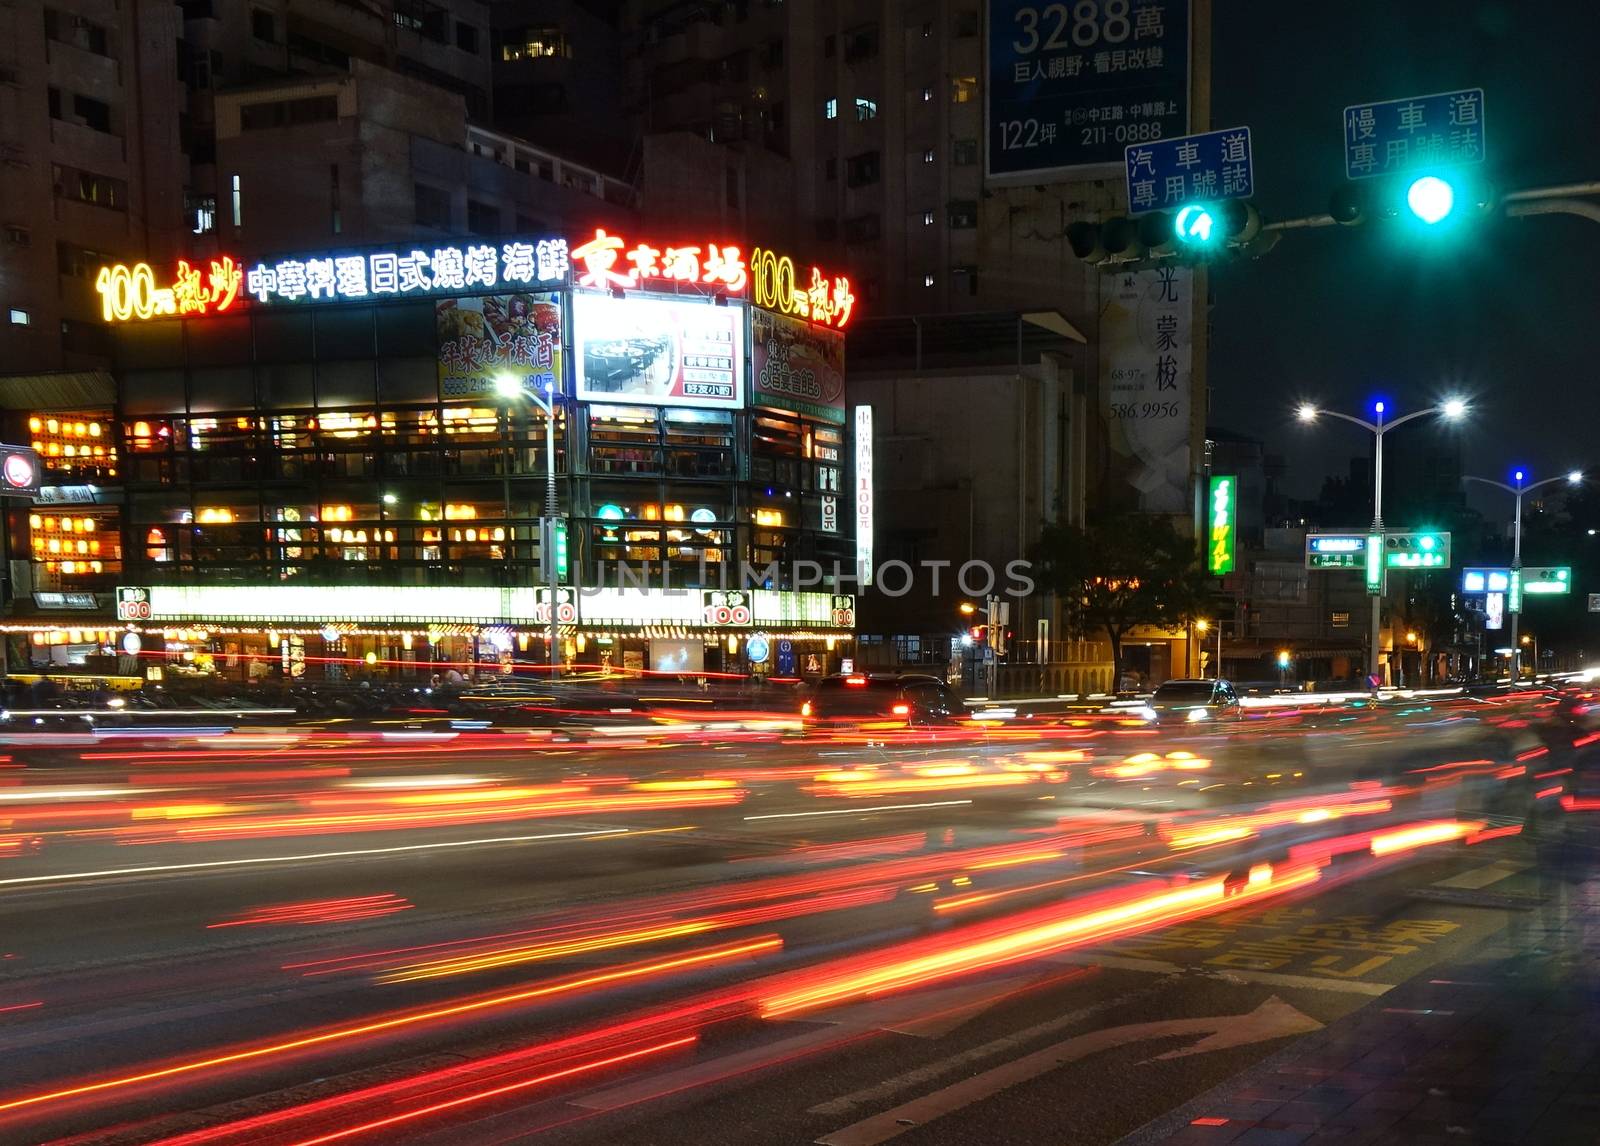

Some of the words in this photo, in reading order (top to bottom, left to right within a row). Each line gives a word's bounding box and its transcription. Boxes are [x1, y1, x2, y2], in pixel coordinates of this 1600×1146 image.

[1013, 0, 1165, 53] 3288萬
[1000, 119, 1056, 150] 122坪
[1081, 122, 1162, 145] 211-0888
[1349, 93, 1478, 141] 慢車道
[1131, 133, 1247, 177] 汽車道
[1350, 127, 1479, 173] 專用號誌
[1132, 164, 1249, 207] 專用號誌
[571, 229, 747, 291] 東京酒場
[1110, 400, 1178, 419] 586.9956
[119, 601, 151, 619] 100
[705, 606, 750, 624] 100
[831, 608, 853, 625] 100
